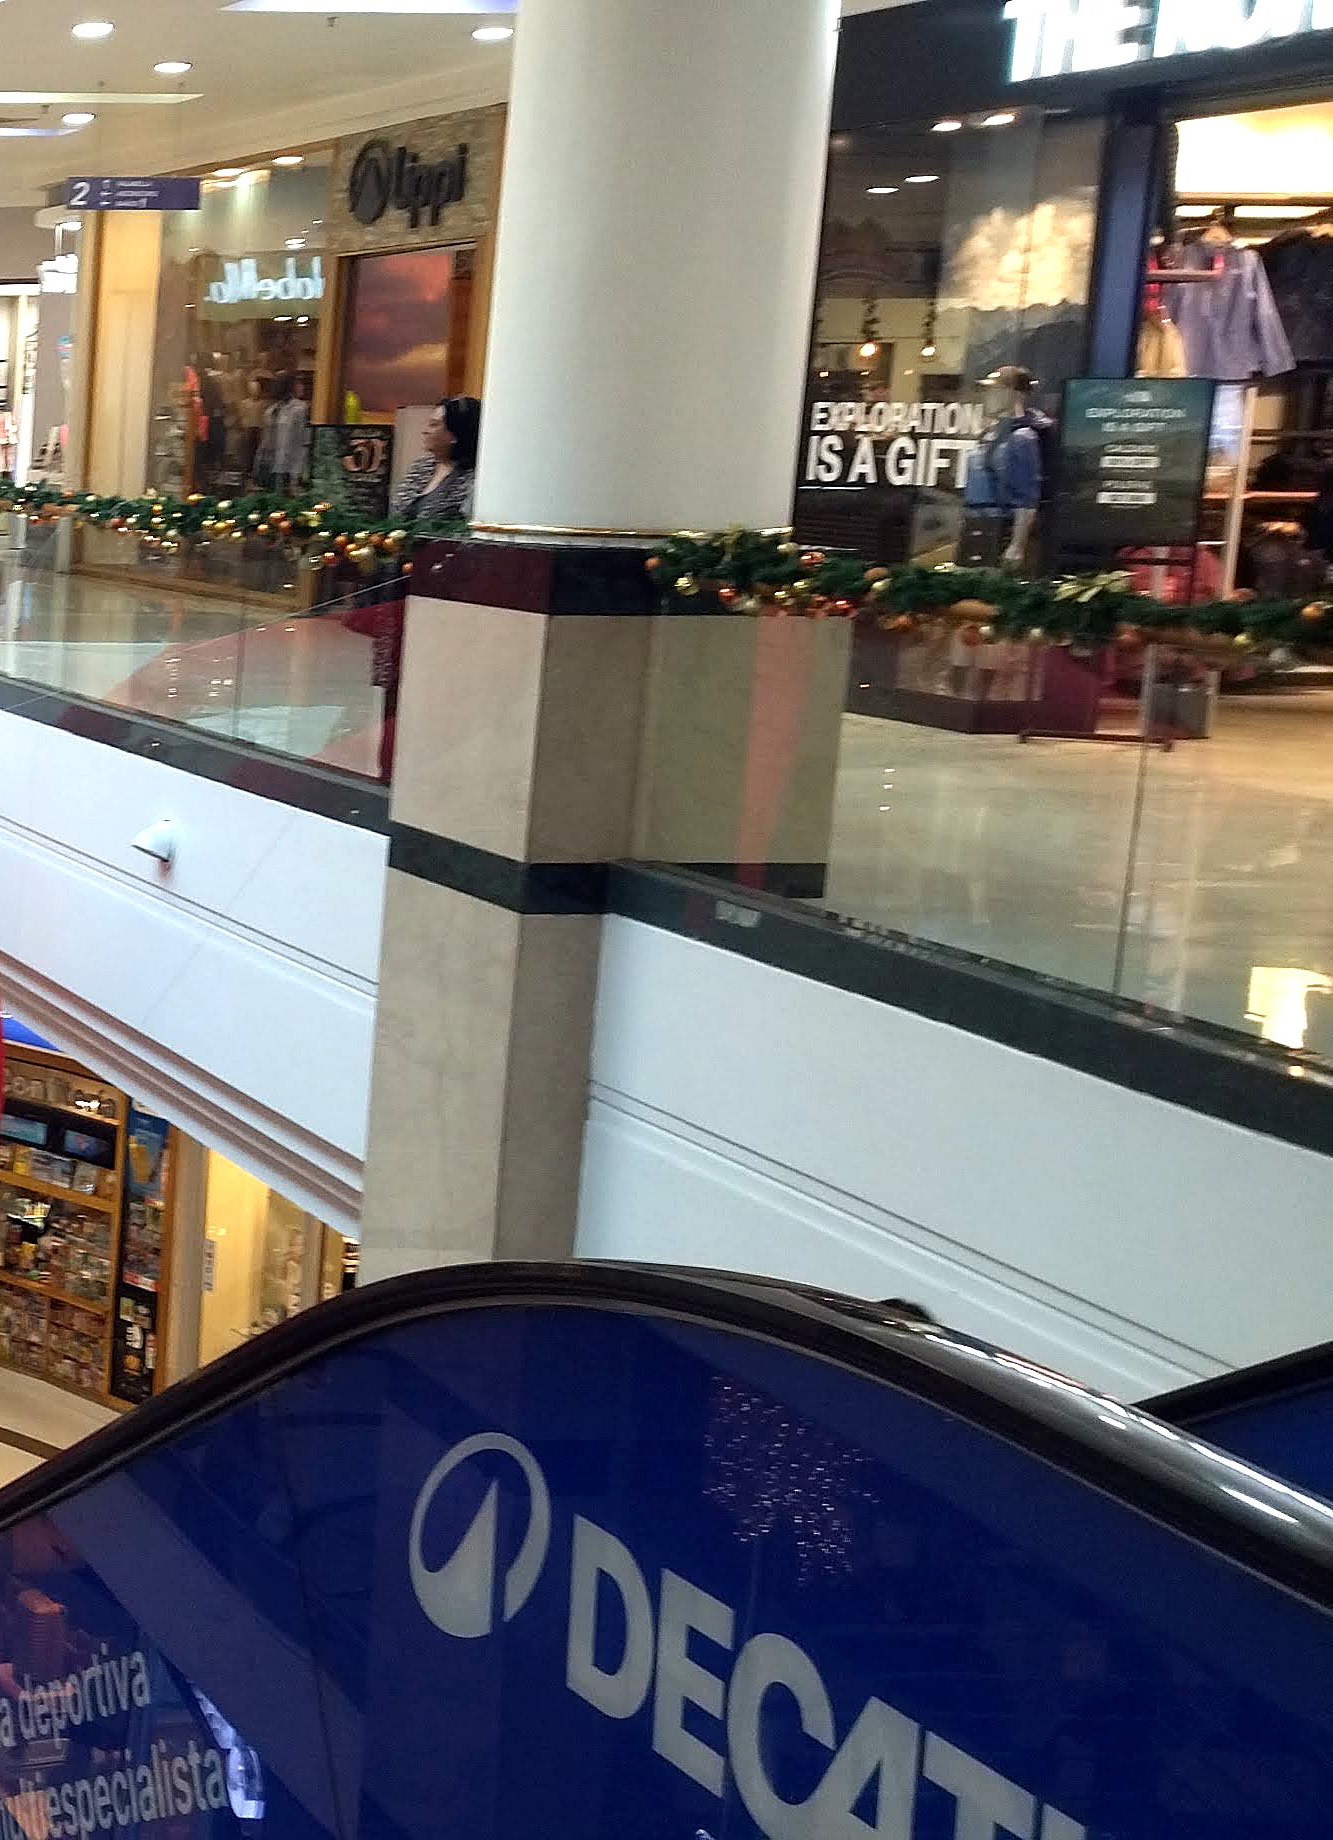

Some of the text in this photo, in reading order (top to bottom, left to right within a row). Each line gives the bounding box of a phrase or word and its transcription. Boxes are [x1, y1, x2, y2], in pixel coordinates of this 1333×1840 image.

[1004, 0, 1333, 82] THE NO
[70, 181, 91, 206] 2
[811, 401, 984, 434] EXPLORATION
[806, 434, 981, 488] IS A GIFT
[18, 1642, 150, 1750] deportiva
[566, 1513, 1087, 1840] DECAT
